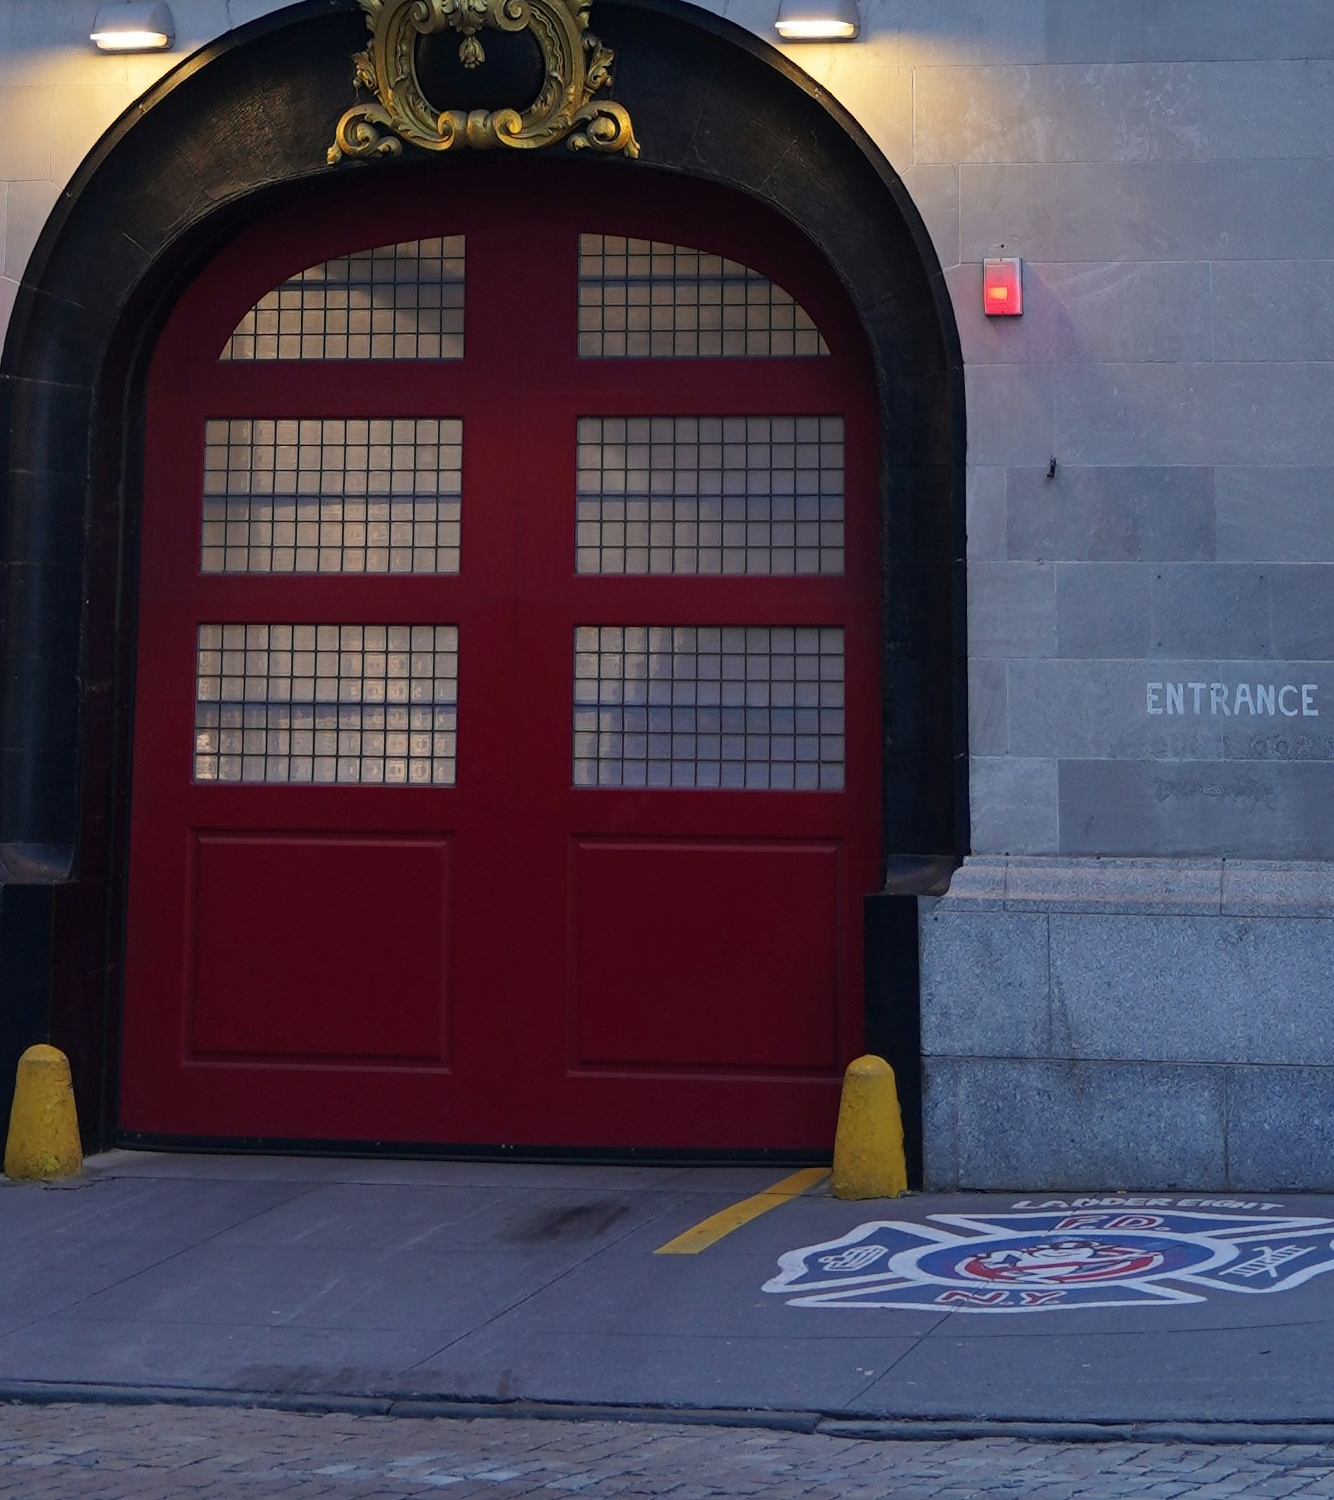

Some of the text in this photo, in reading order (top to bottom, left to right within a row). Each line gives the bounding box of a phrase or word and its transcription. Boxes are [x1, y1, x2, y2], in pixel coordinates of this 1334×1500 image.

[1146, 681, 1320, 717] ENTRANCE
[1011, 1197, 1286, 1212] LADDER EIGHT
